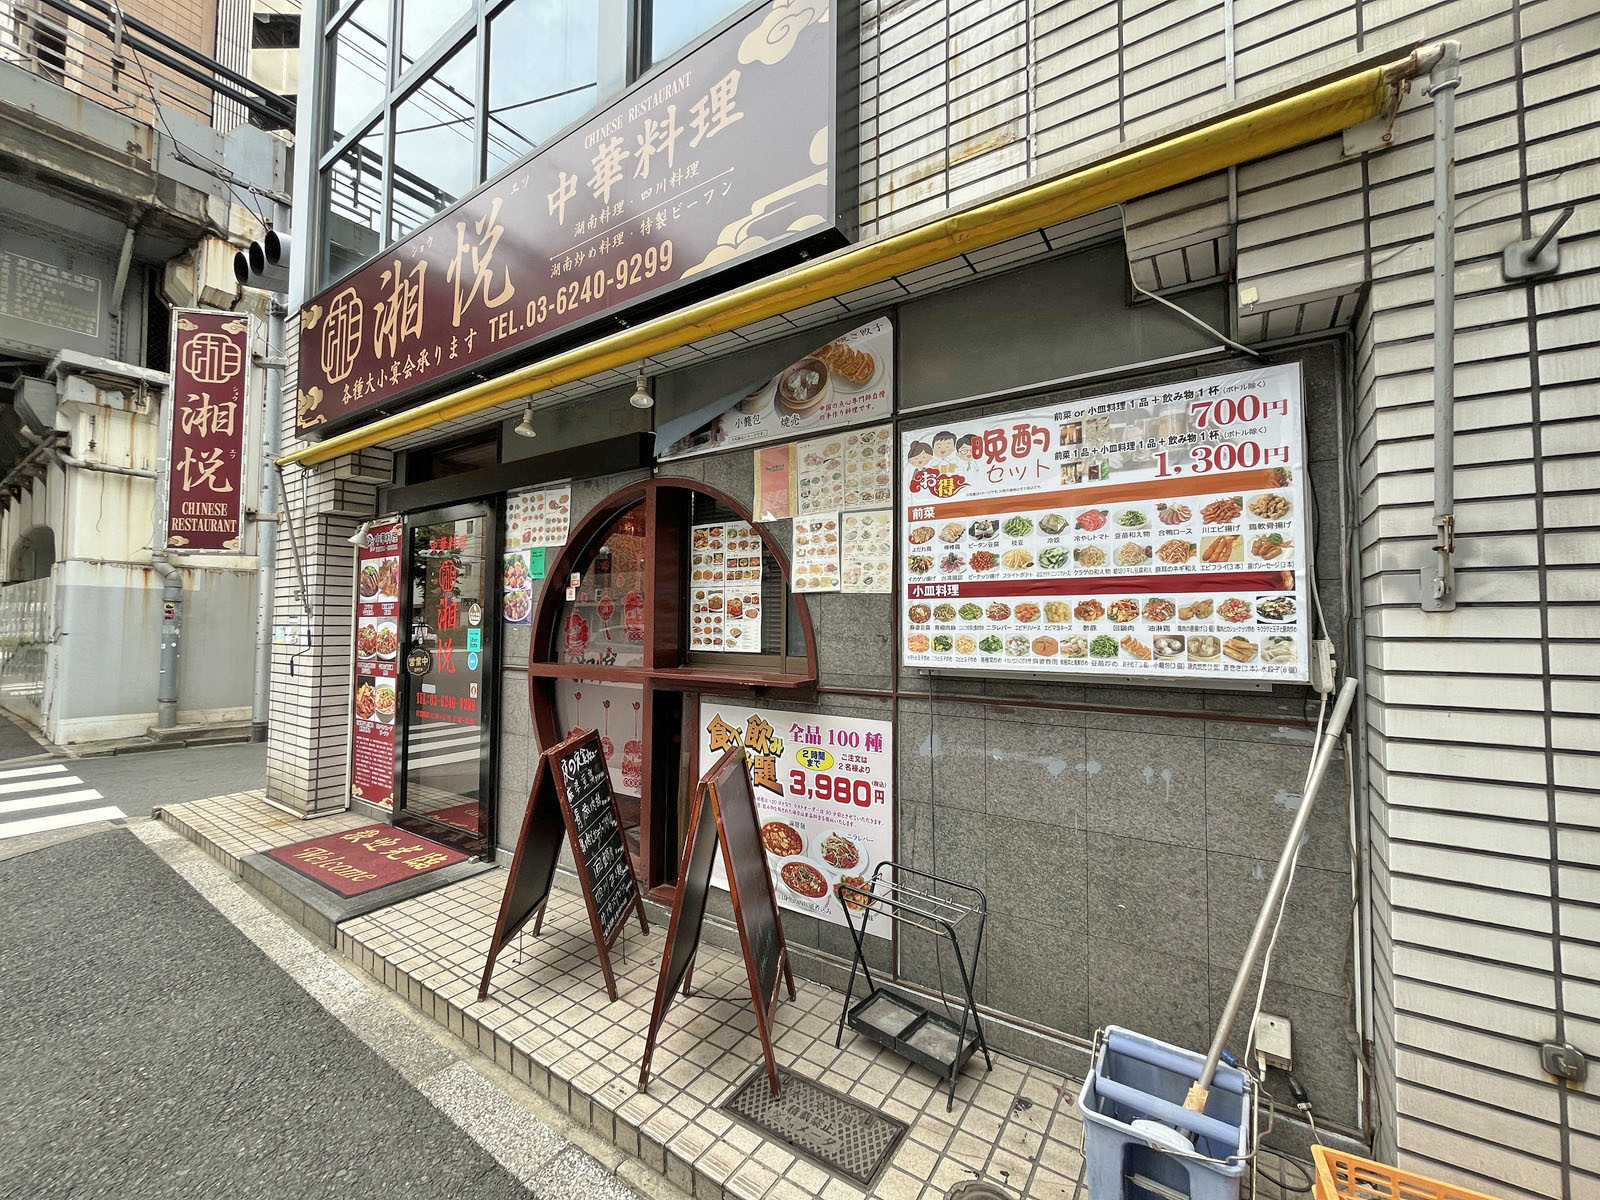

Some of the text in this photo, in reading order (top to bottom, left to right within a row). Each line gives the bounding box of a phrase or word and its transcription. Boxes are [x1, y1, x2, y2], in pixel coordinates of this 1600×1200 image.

[584, 71, 692, 149] CHINESE RESTAURANT
[547, 69, 745, 225] 中華料理
[373, 197, 516, 360] 湘悦
[342, 328, 478, 406] 各種大小宴会承ります
[819, 404, 876, 420] の手作り料理です。
[1191, 394, 1288, 429] 700円
[734, 413, 761, 429] 小籠包
[780, 412, 800, 428] 焼売
[176, 392, 238, 493] 湘悦
[971, 423, 1050, 465] 晩酌
[986, 459, 1050, 483] セット
[919, 470, 955, 497] お得
[181, 501, 228, 518] CHINESE
[912, 506, 935, 520] 前菜
[171, 517, 237, 533] RESTAURANT
[1201, 524, 1241, 534] 川エビ揚げ
[1248, 521, 1292, 531] 鶏軟骨揚げ
[1073, 533, 1110, 542] 冷やしトマト
[1114, 531, 1151, 540] 豆苗和え物
[1157, 528, 1193, 537] 合鴨ロース
[968, 541, 1000, 549] ピータン豆腐
[1073, 568, 1111, 576] クラゲの和え物
[1155, 564, 1198, 573] 豚耳のネギ和え
[912, 584, 960, 597] 小皿料理
[1083, 624, 1097, 632] 酢豚
[1113, 624, 1135, 632] 回鍋肉
[1148, 624, 1171, 632] 油淋鶏
[408, 655, 429, 667] 営業中
[789, 723, 883, 753] 全品 100 種
[806, 759, 821, 768] まで
[841, 753, 868, 764] ご注文は
[846, 832, 875, 843] ニラレバー
[293, 846, 380, 882] Welcome
